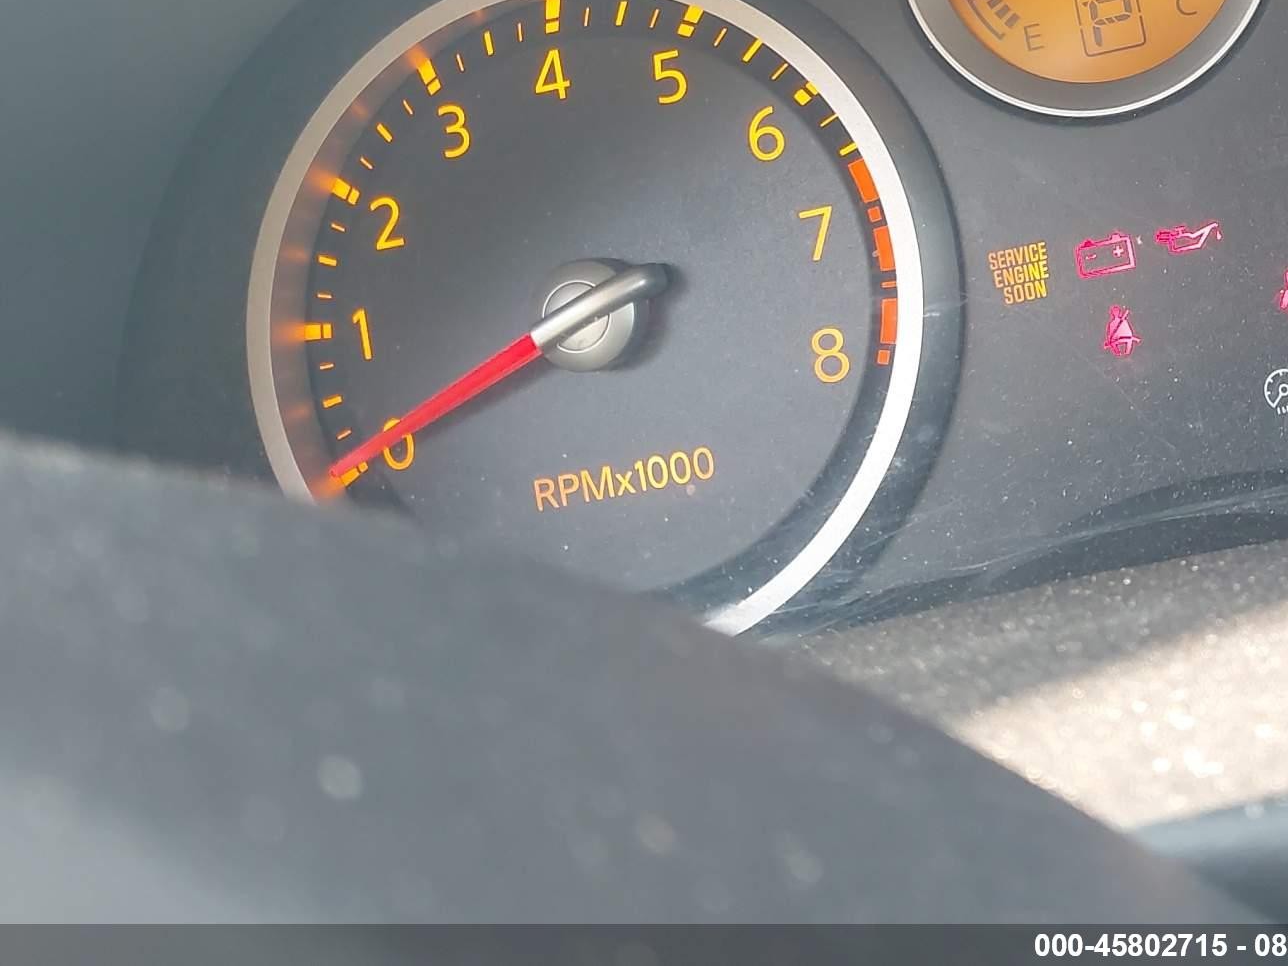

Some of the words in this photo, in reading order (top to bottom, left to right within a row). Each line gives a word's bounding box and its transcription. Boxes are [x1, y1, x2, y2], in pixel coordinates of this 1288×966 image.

[1024, 23, 1045, 52] E
[534, 49, 571, 100] 4
[652, 50, 688, 104] 5
[437, 104, 471, 158] 3
[747, 106, 786, 162] 6
[369, 197, 405, 250] 2
[799, 206, 834, 261] 7
[988, 242, 1047, 270] SERVICE
[994, 261, 1049, 288] ENGINE
[1006, 281, 1047, 305] SOON
[351, 309, 372, 359] 1
[810, 328, 851, 383] 8
[382, 417, 416, 471] 0
[533, 445, 716, 512] RPMx1000
